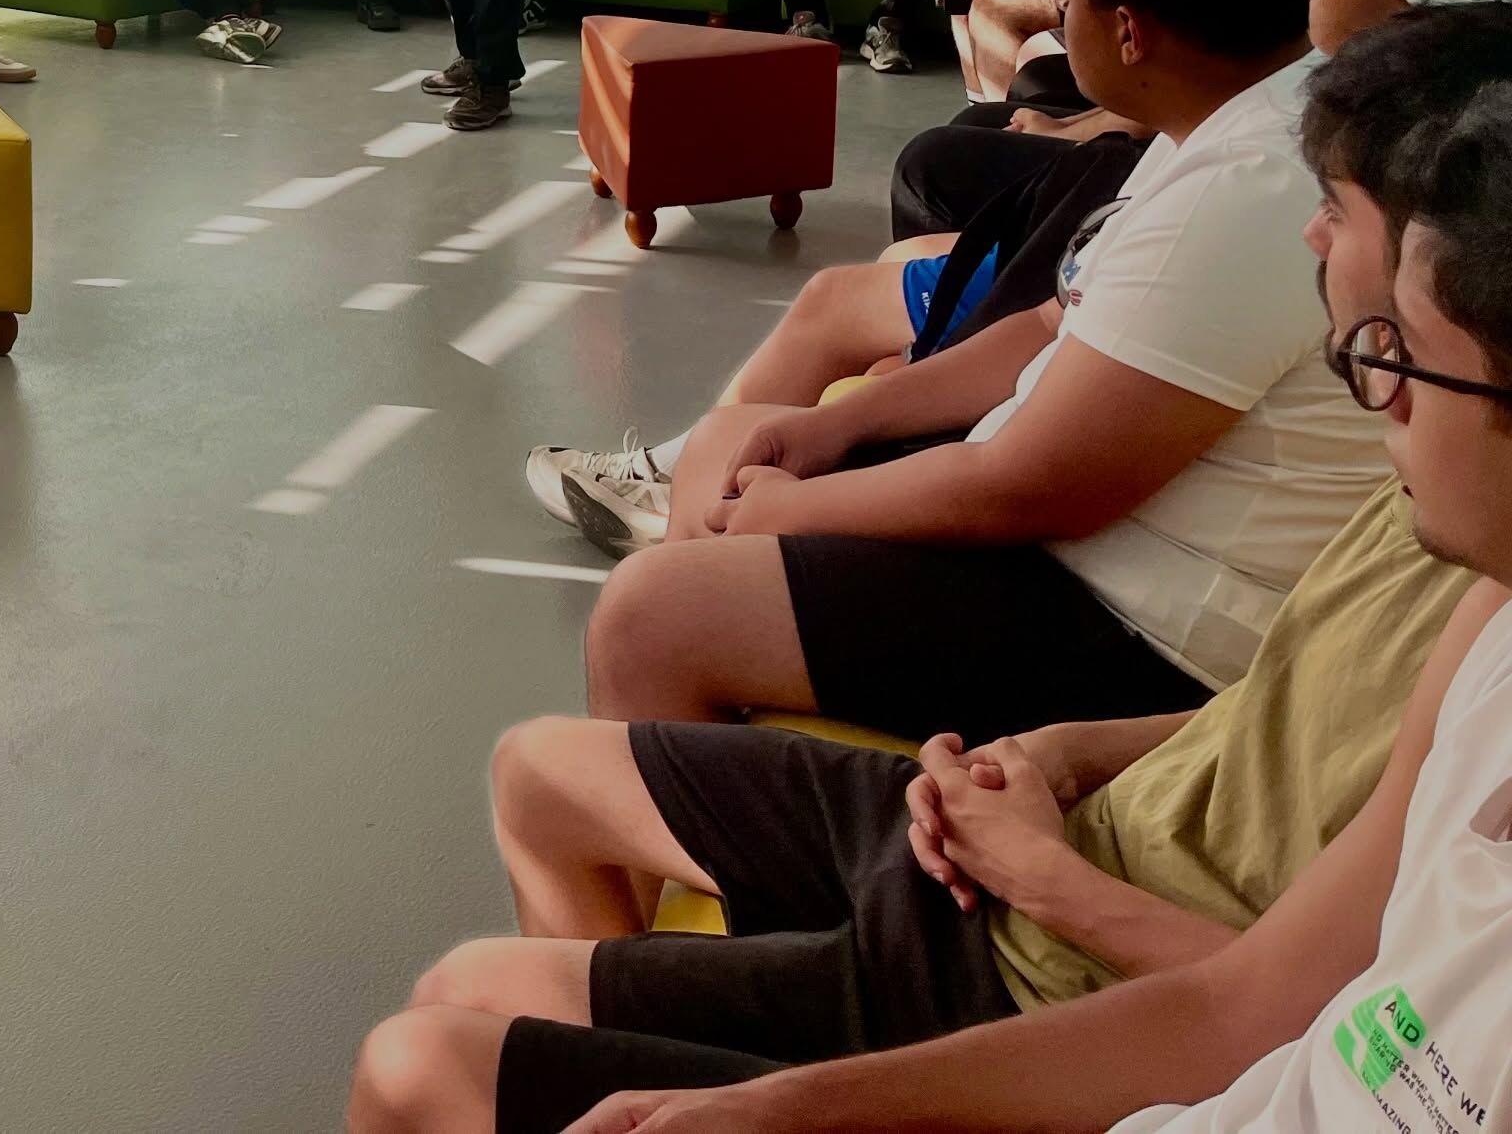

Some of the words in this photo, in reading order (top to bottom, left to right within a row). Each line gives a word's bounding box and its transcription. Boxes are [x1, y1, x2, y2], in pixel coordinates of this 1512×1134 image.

[1384, 1000, 1420, 1043] AND
[1424, 1041, 1458, 1097] HERE
[1460, 1091, 1486, 1127] WE
